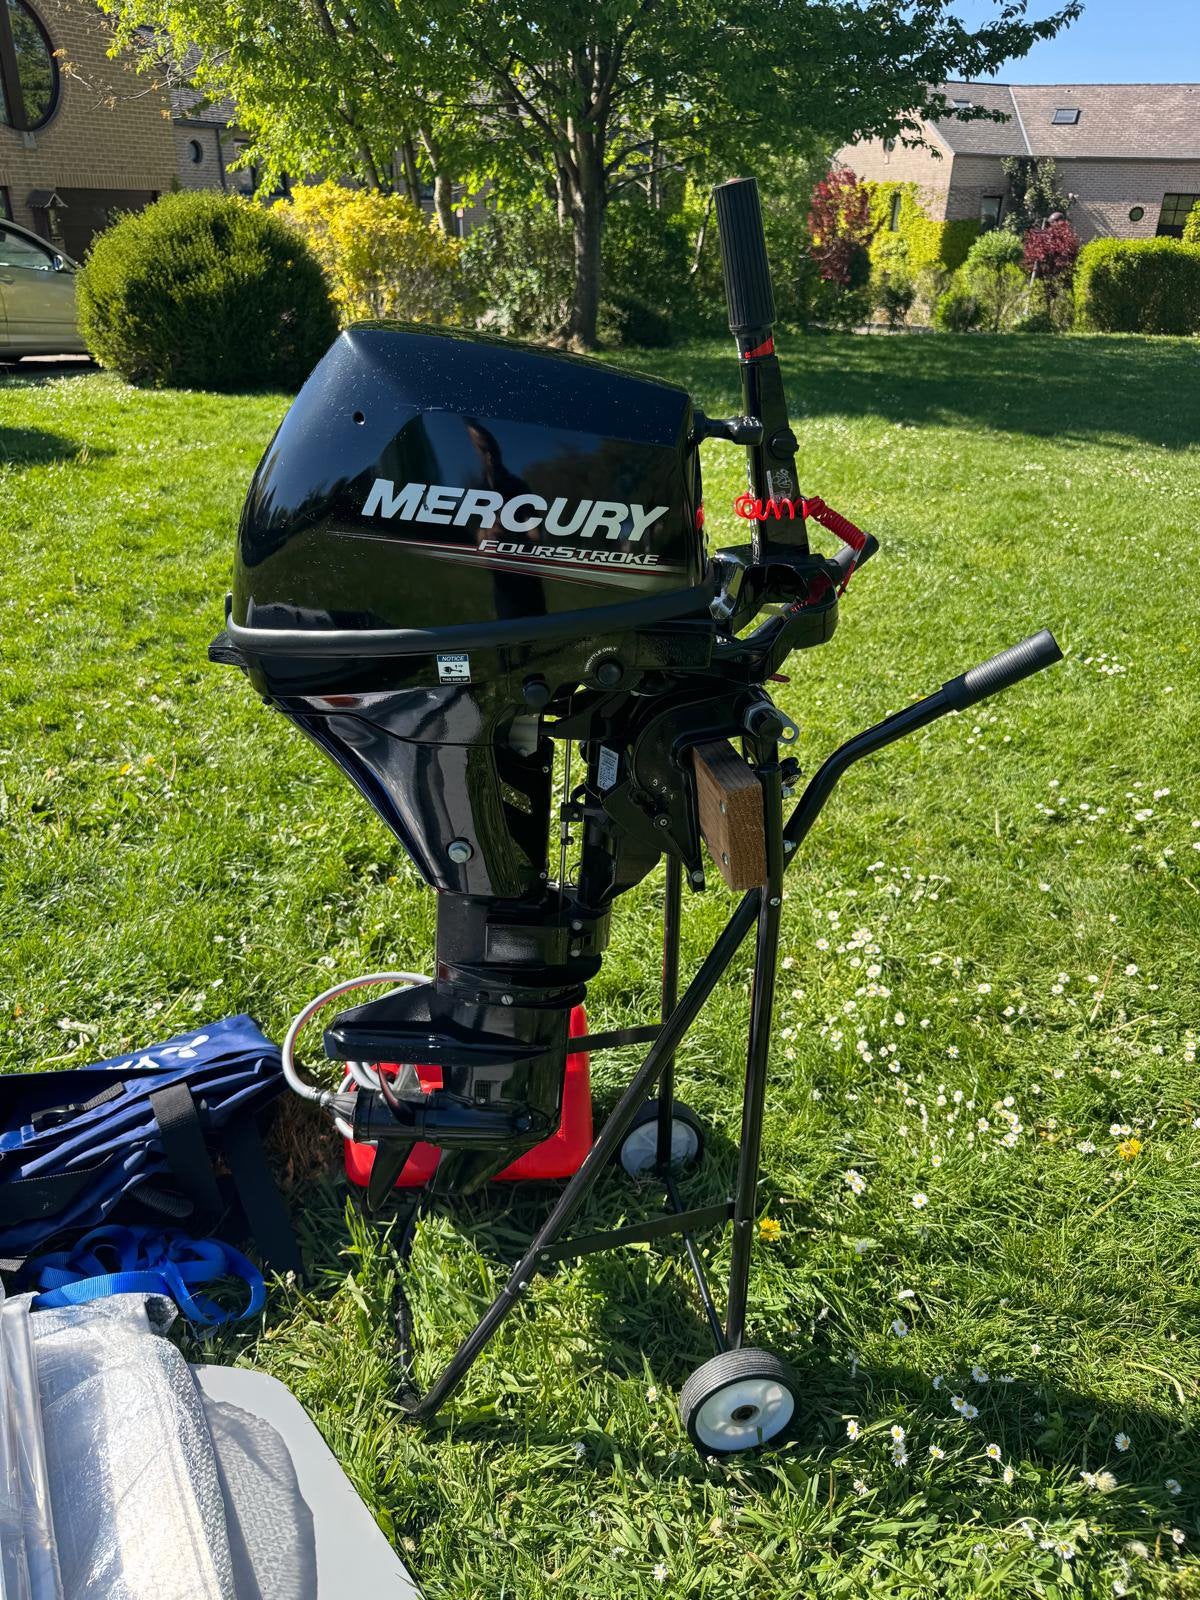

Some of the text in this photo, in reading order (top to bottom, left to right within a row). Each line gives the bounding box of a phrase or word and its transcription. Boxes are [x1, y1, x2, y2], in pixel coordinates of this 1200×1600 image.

[361, 478, 669, 541] MERCURY
[477, 539, 660, 566] FOURSTROKE
[652, 778, 658, 786] 3
